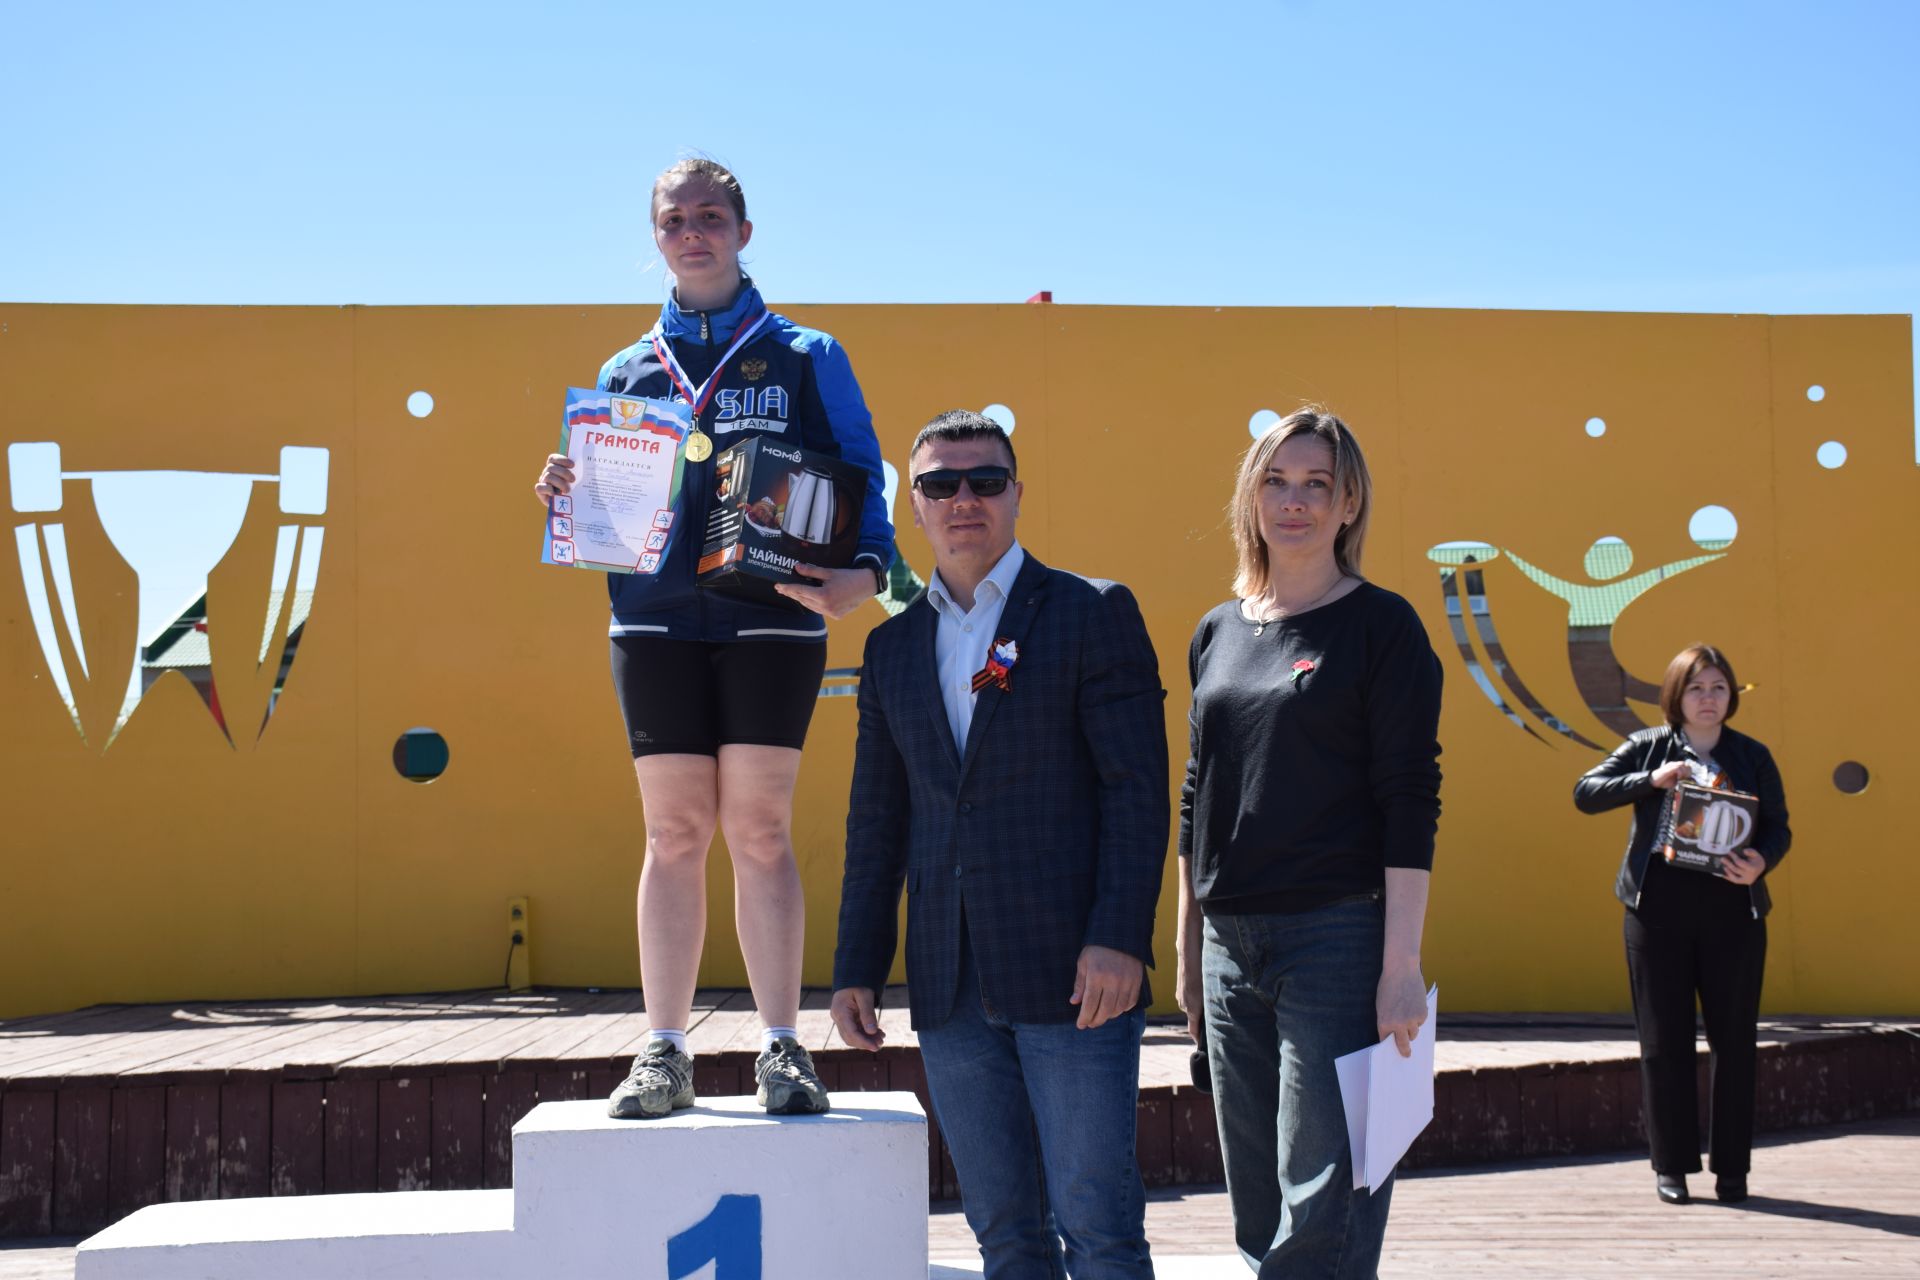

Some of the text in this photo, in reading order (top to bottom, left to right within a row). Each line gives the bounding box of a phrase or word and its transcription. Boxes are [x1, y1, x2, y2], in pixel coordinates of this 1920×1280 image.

[715, 385, 788, 419] SIA
[731, 419, 769, 430] TEAM
[585, 431, 661, 454] ГРАМОТА
[586, 455, 652, 470] НАГРАЖДАЕТСЯ
[749, 546, 799, 569] ЧАЙНИК
[667, 1193, 762, 1280] 1
